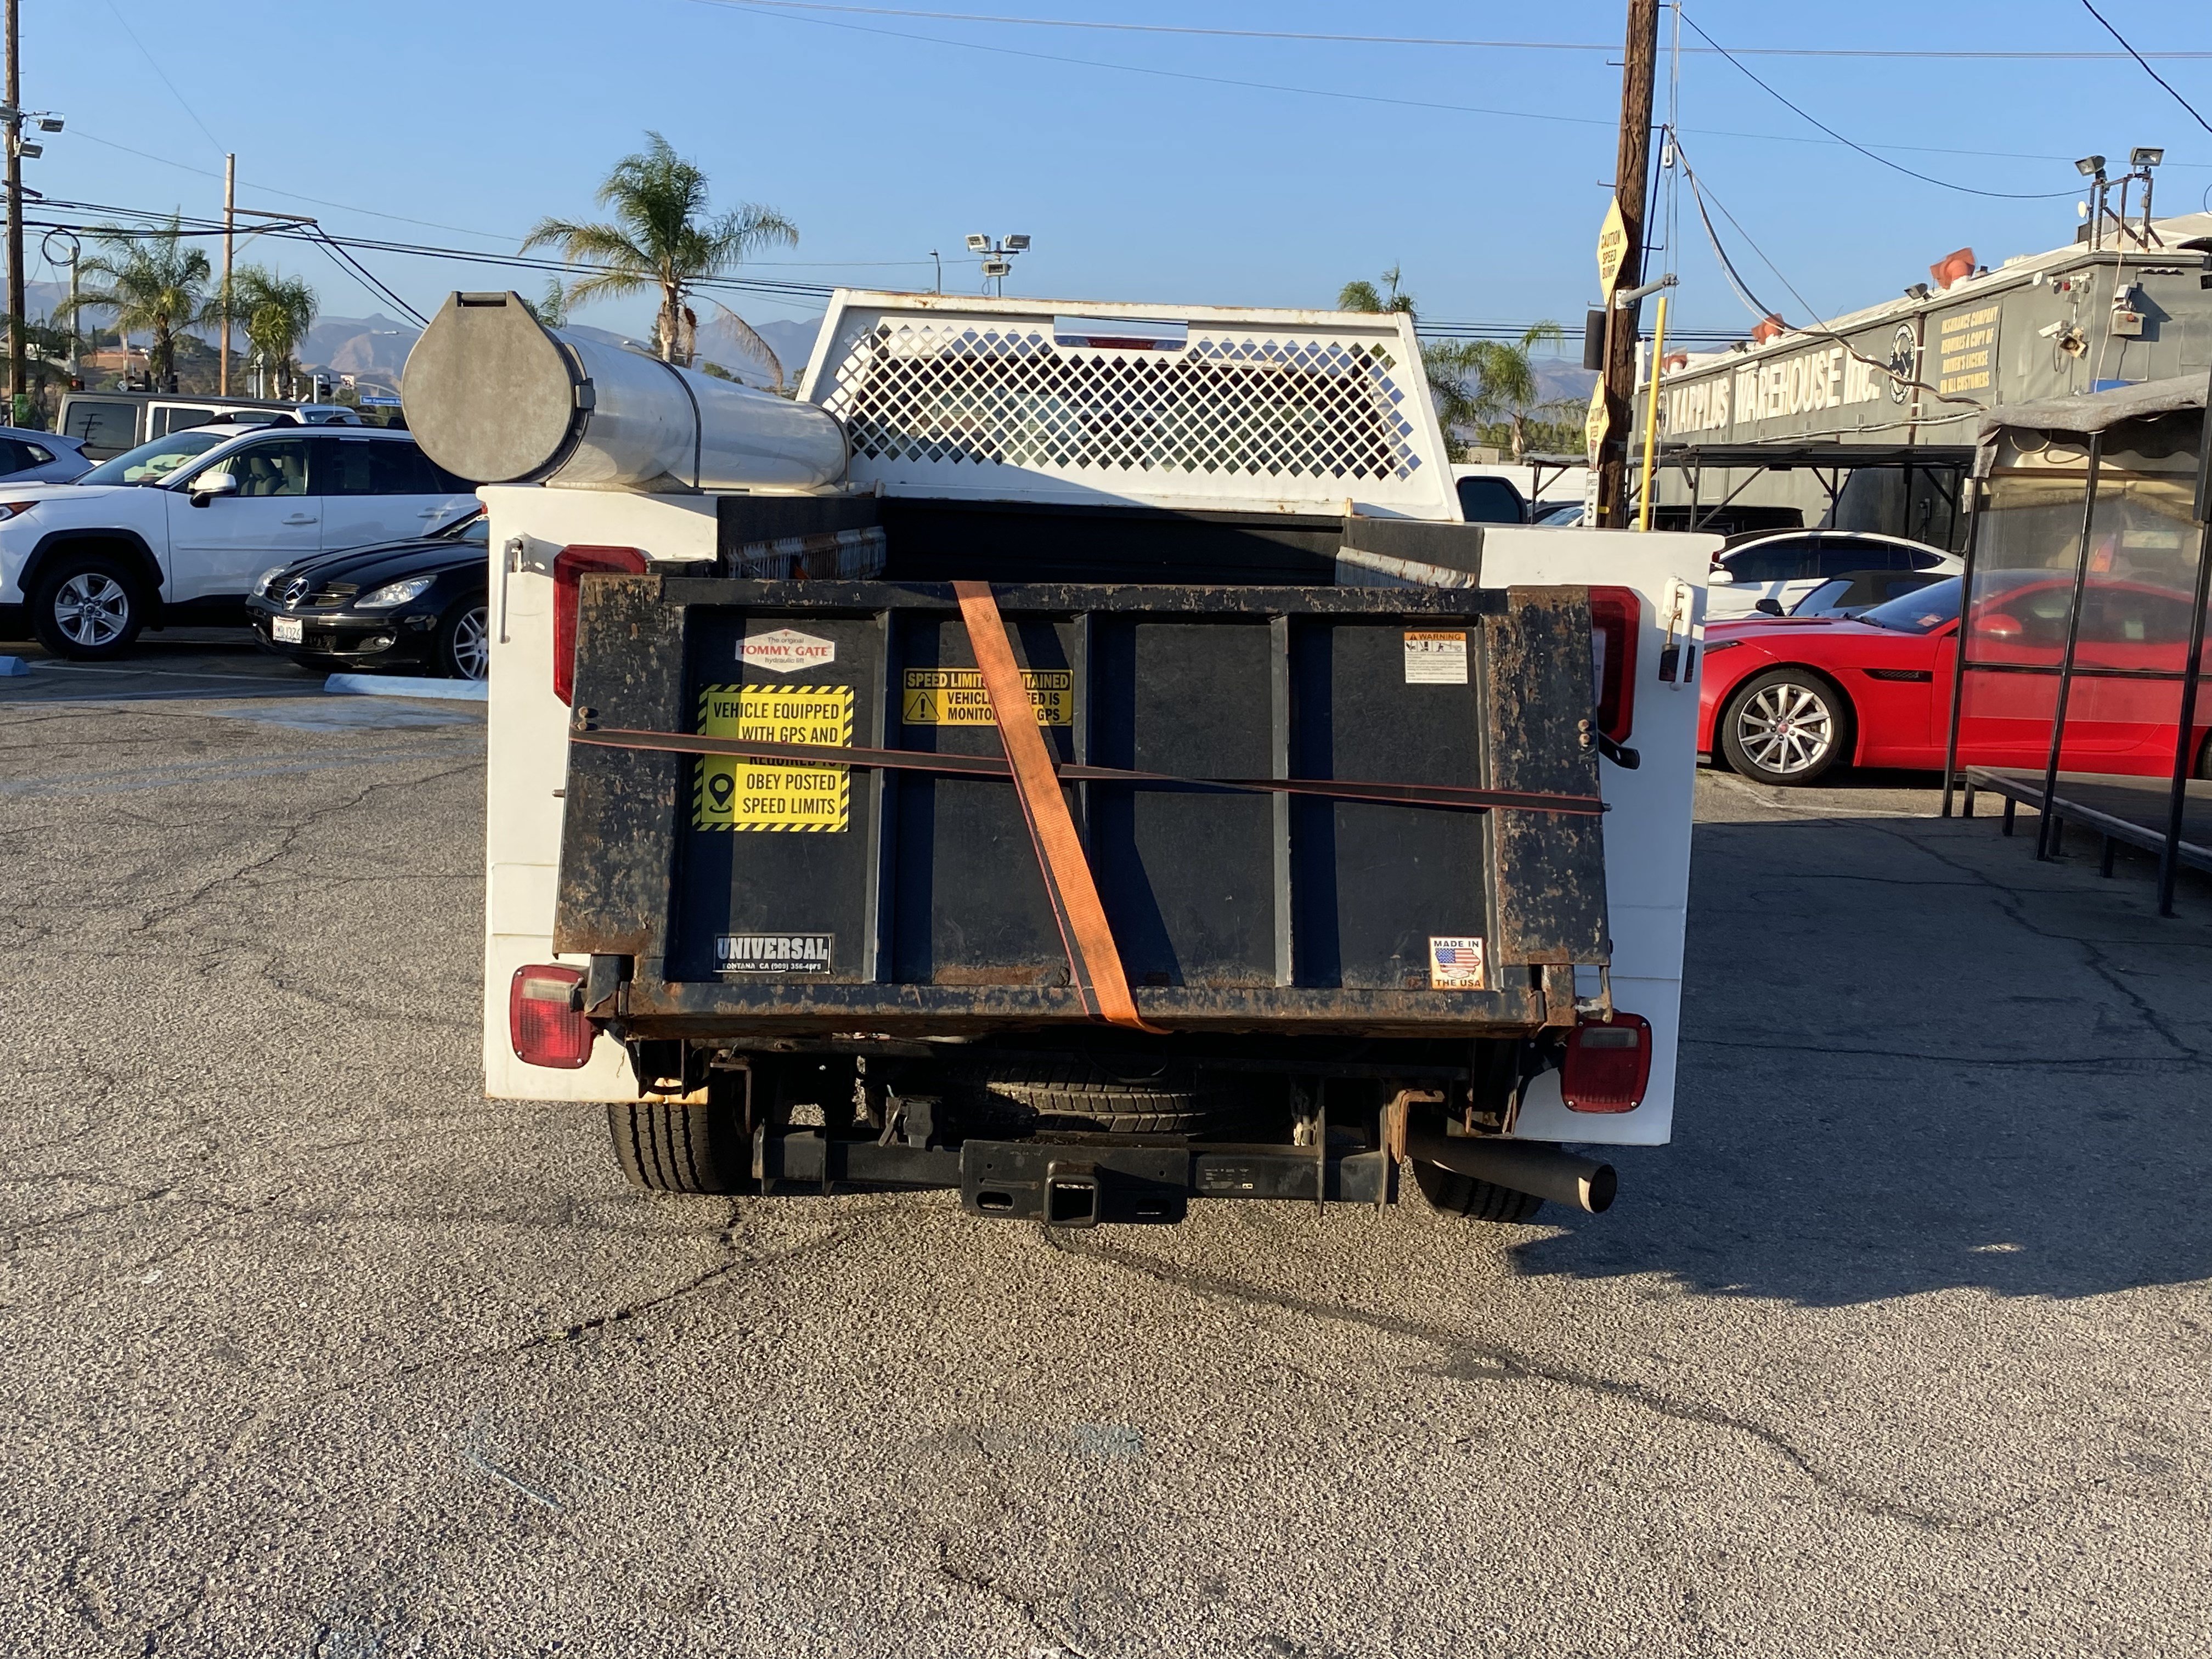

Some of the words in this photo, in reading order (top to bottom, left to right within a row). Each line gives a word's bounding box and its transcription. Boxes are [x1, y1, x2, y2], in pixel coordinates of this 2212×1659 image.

[1601, 229, 1621, 249] CAUTION
[1602, 249, 1617, 264] SPEED
[1602, 264, 1615, 279] BUMP
[1941, 313, 1971, 334] INSURANCE
[1970, 306, 1999, 328] COMPANY
[1965, 333, 1970, 348] A
[1970, 330, 1986, 348] COPY
[1986, 328, 1994, 344] OF
[1966, 350, 1989, 369] LICENSE
[1956, 370, 1990, 391] CUSTOMERS
[1671, 377, 1730, 435] KARPLUS
[1735, 347, 1843, 424] WAREHOUSE
[1587, 502, 1594, 519] 5
[740, 645, 790, 655] TOMMY
[795, 646, 828, 657] GATE
[907, 673, 947, 687] SPEED
[951, 673, 987, 688] LIMIT
[1049, 692, 1060, 706] IS
[713, 702, 769, 718] VEHICLE
[774, 703, 839, 719] EQUIPPED
[1037, 708, 1060, 721] GPS
[742, 726, 774, 742] WITH
[780, 727, 806, 743] GPS
[810, 727, 838, 743] AND
[747, 774, 781, 790] OBEY
[786, 774, 836, 790] POSTED
[742, 797, 786, 814] SPEED
[791, 798, 835, 814] LIMITS
[717, 938, 828, 960] UNIVERSAL
